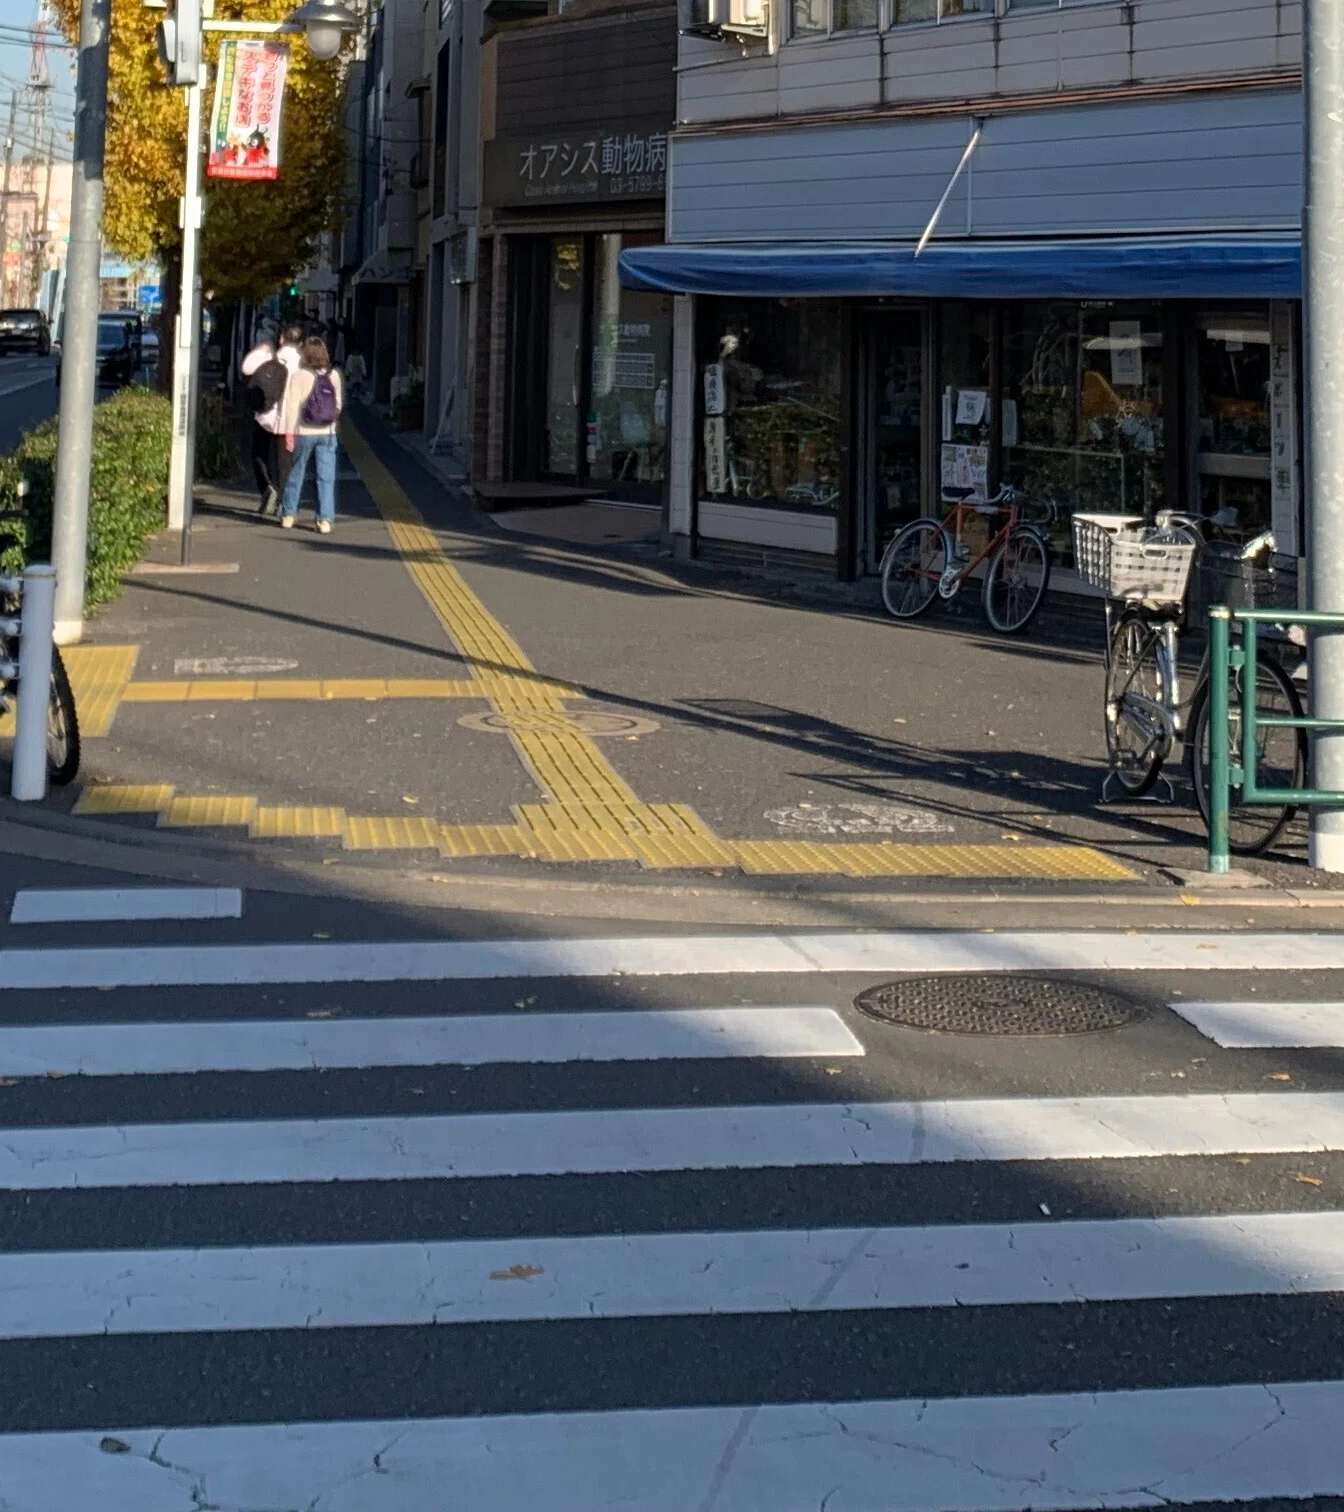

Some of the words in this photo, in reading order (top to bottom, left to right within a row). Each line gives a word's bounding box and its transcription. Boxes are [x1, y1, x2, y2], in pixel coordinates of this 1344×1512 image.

[519, 134, 666, 180] オアシス動物病
